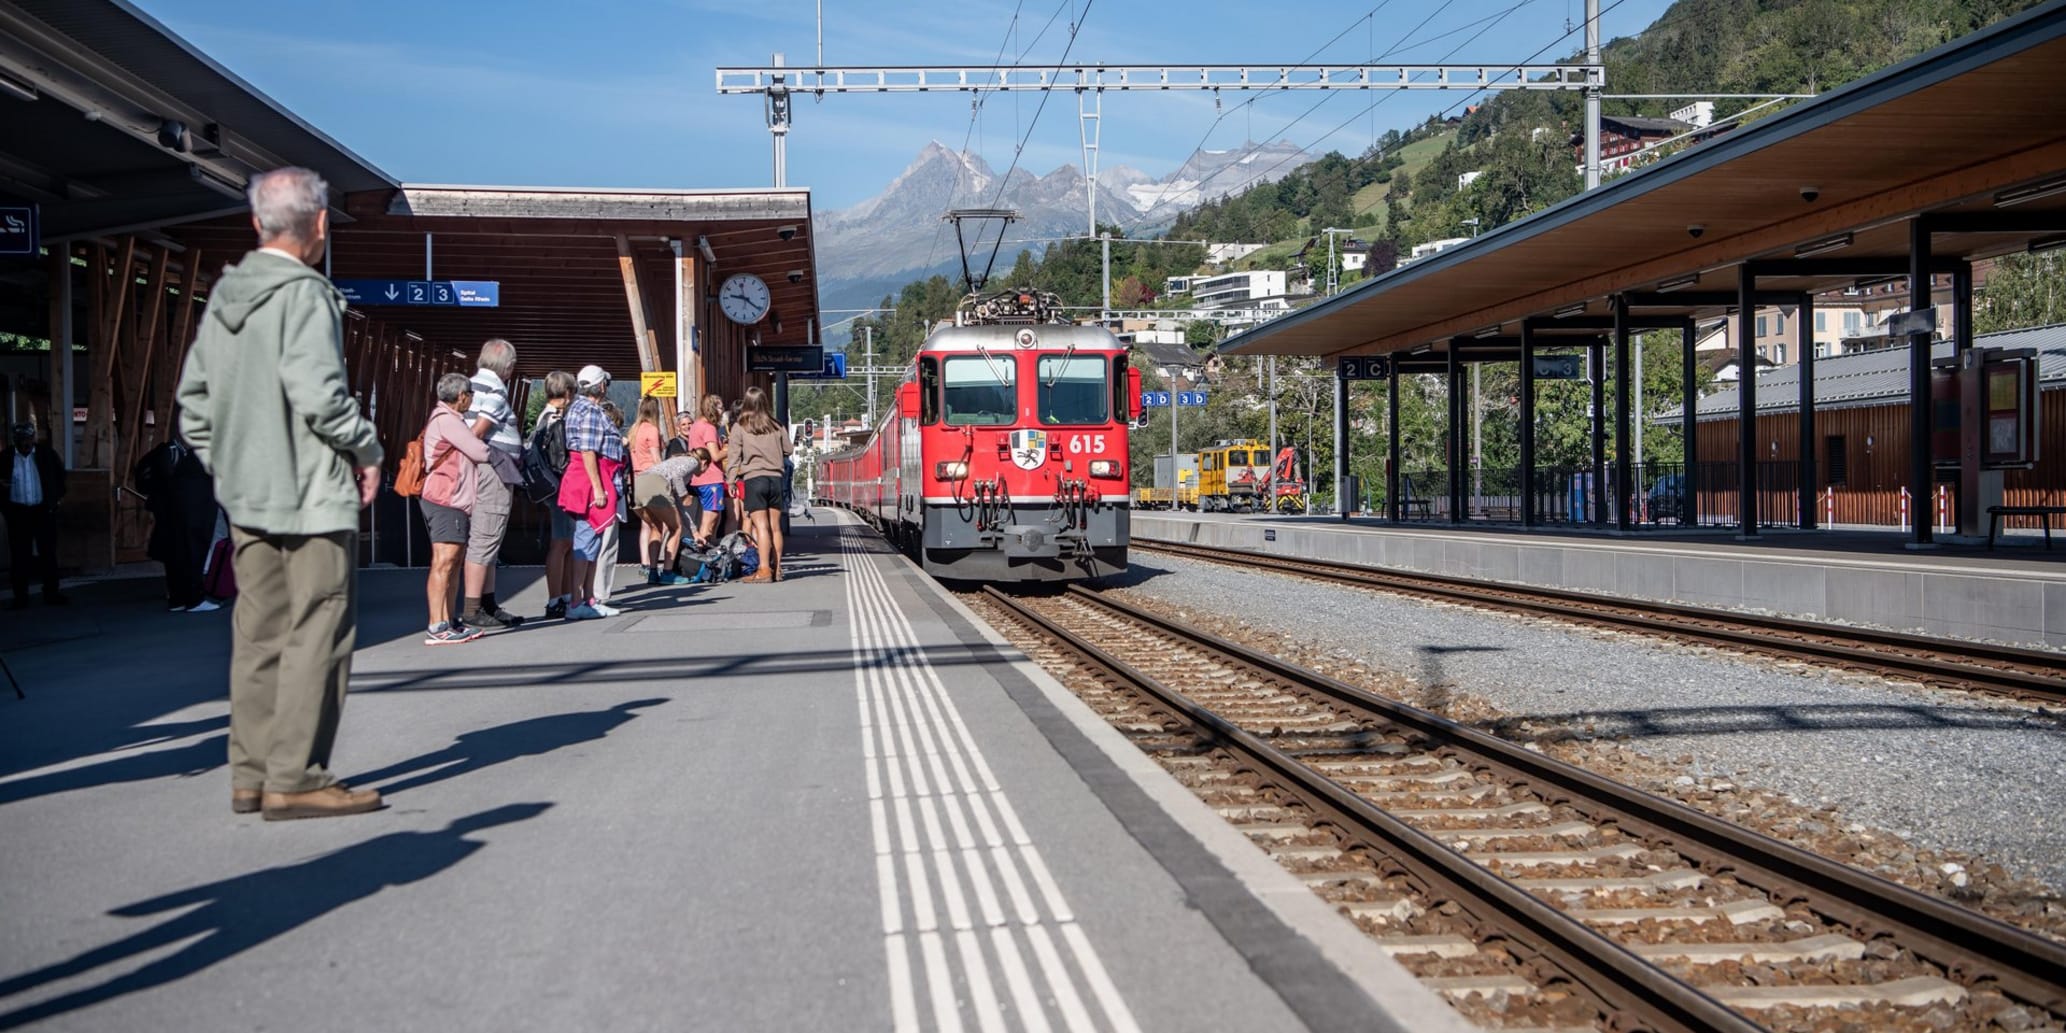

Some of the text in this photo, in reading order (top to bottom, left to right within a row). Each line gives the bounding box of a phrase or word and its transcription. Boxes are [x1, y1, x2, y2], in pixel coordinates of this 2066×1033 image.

[413, 288, 449, 302] 2 3
[828, 361, 836, 374] 1
[1346, 363, 1381, 377] 2 C
[1563, 362, 1572, 375] 3
[1146, 395, 1167, 404] 2 D
[1182, 395, 1203, 404] 3 D
[1069, 434, 1105, 454] 615
